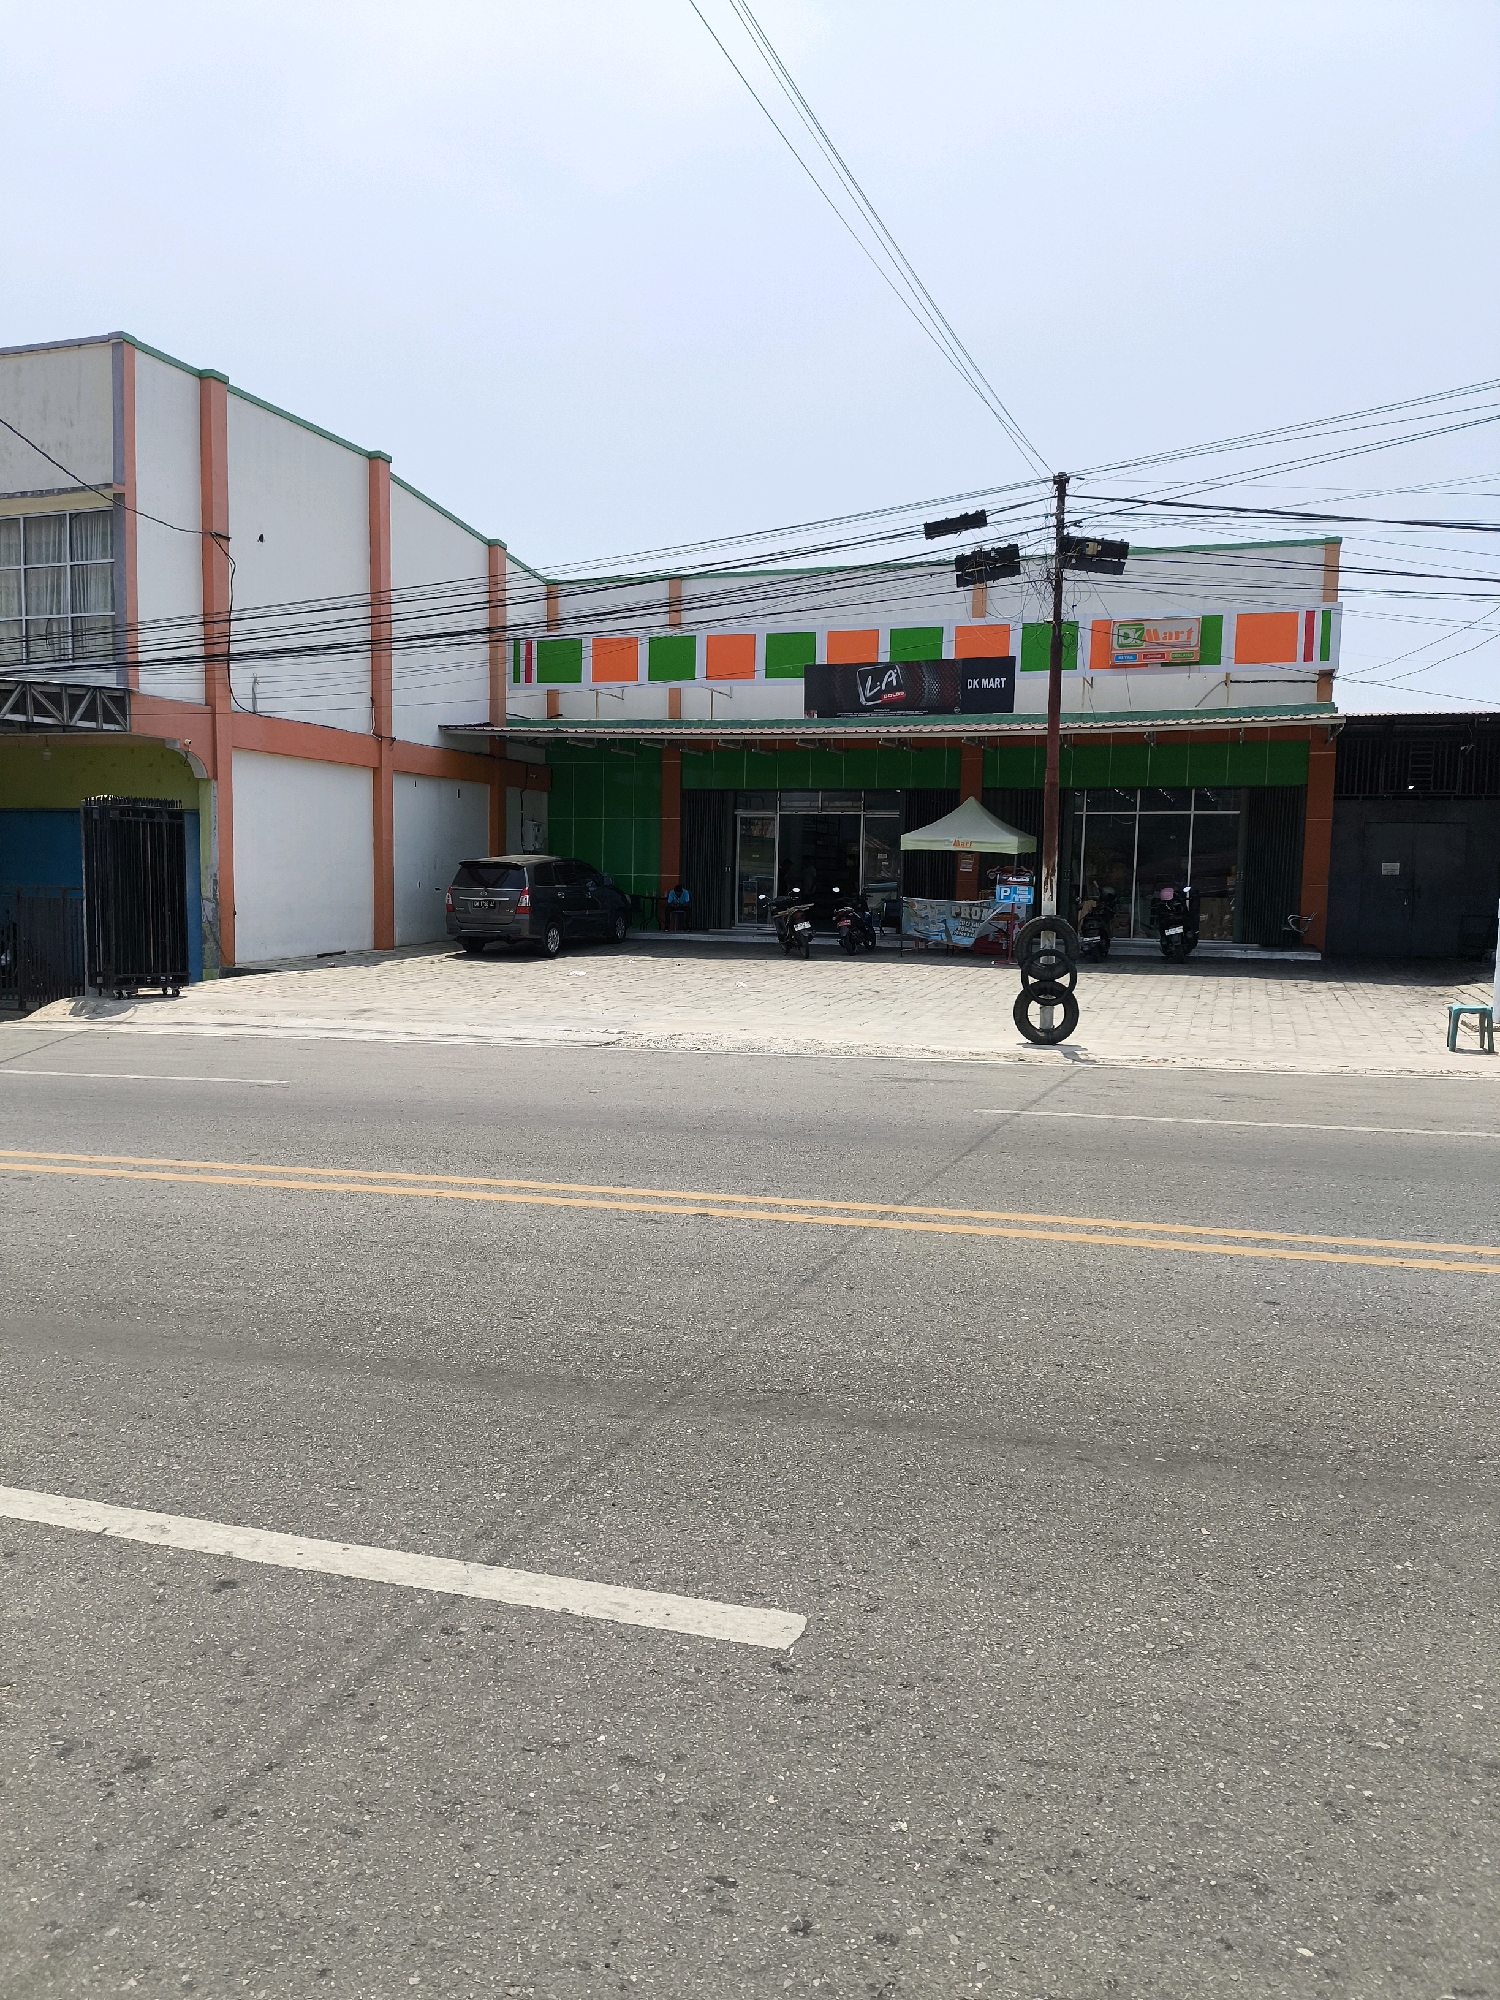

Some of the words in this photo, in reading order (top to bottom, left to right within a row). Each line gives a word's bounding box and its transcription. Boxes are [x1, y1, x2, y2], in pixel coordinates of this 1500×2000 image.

[1142, 627, 1194, 642] Mart
[967, 679, 980, 689] DK
[981, 677, 1007, 689] MART
[1001, 887, 1011, 900] P
